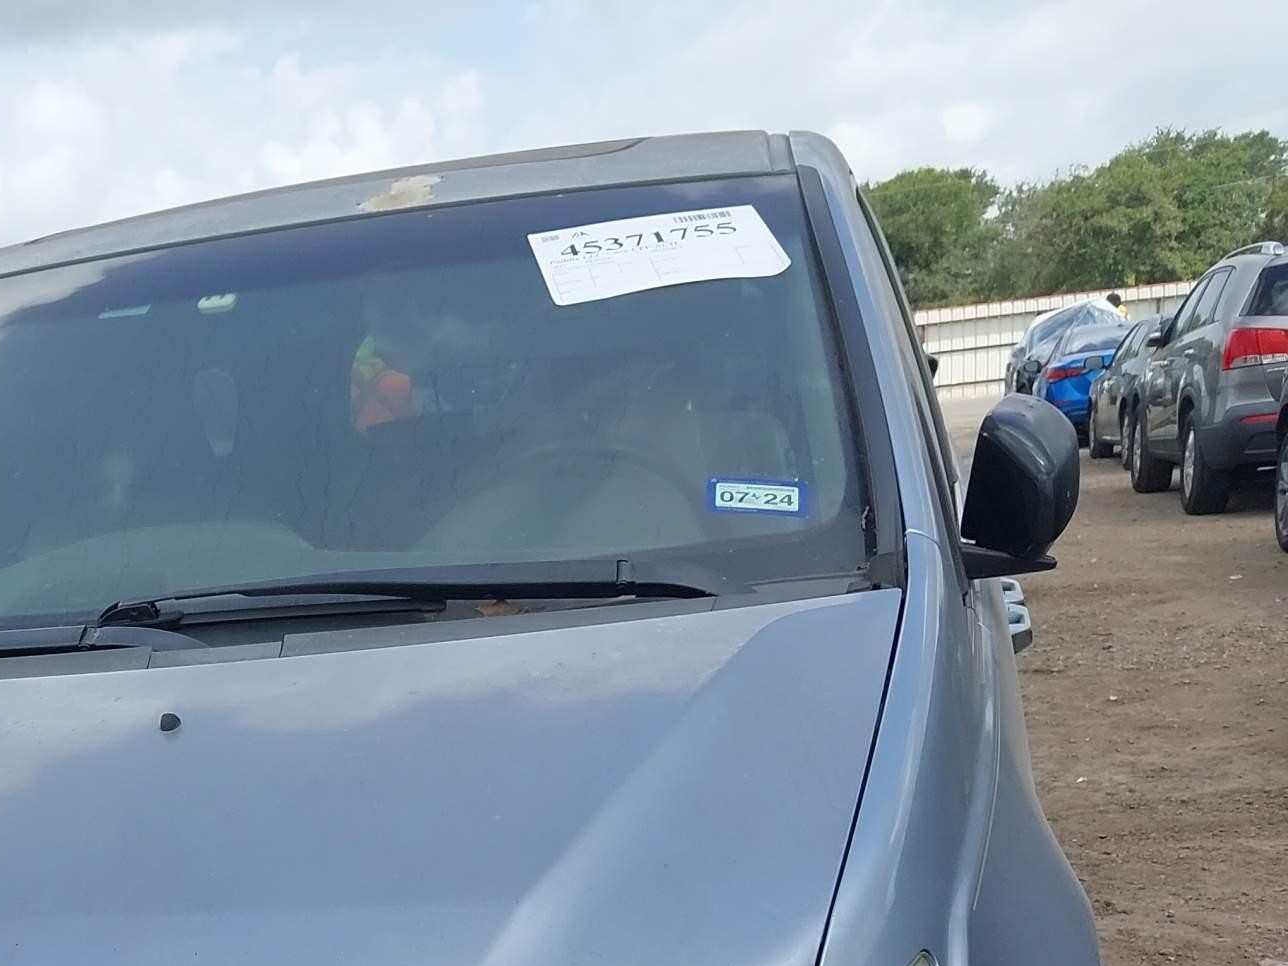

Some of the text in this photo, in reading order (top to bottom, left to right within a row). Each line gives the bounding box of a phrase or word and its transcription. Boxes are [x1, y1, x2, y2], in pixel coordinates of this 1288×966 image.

[560, 221, 738, 258] 45371755
[719, 490, 795, 507] 07 24
